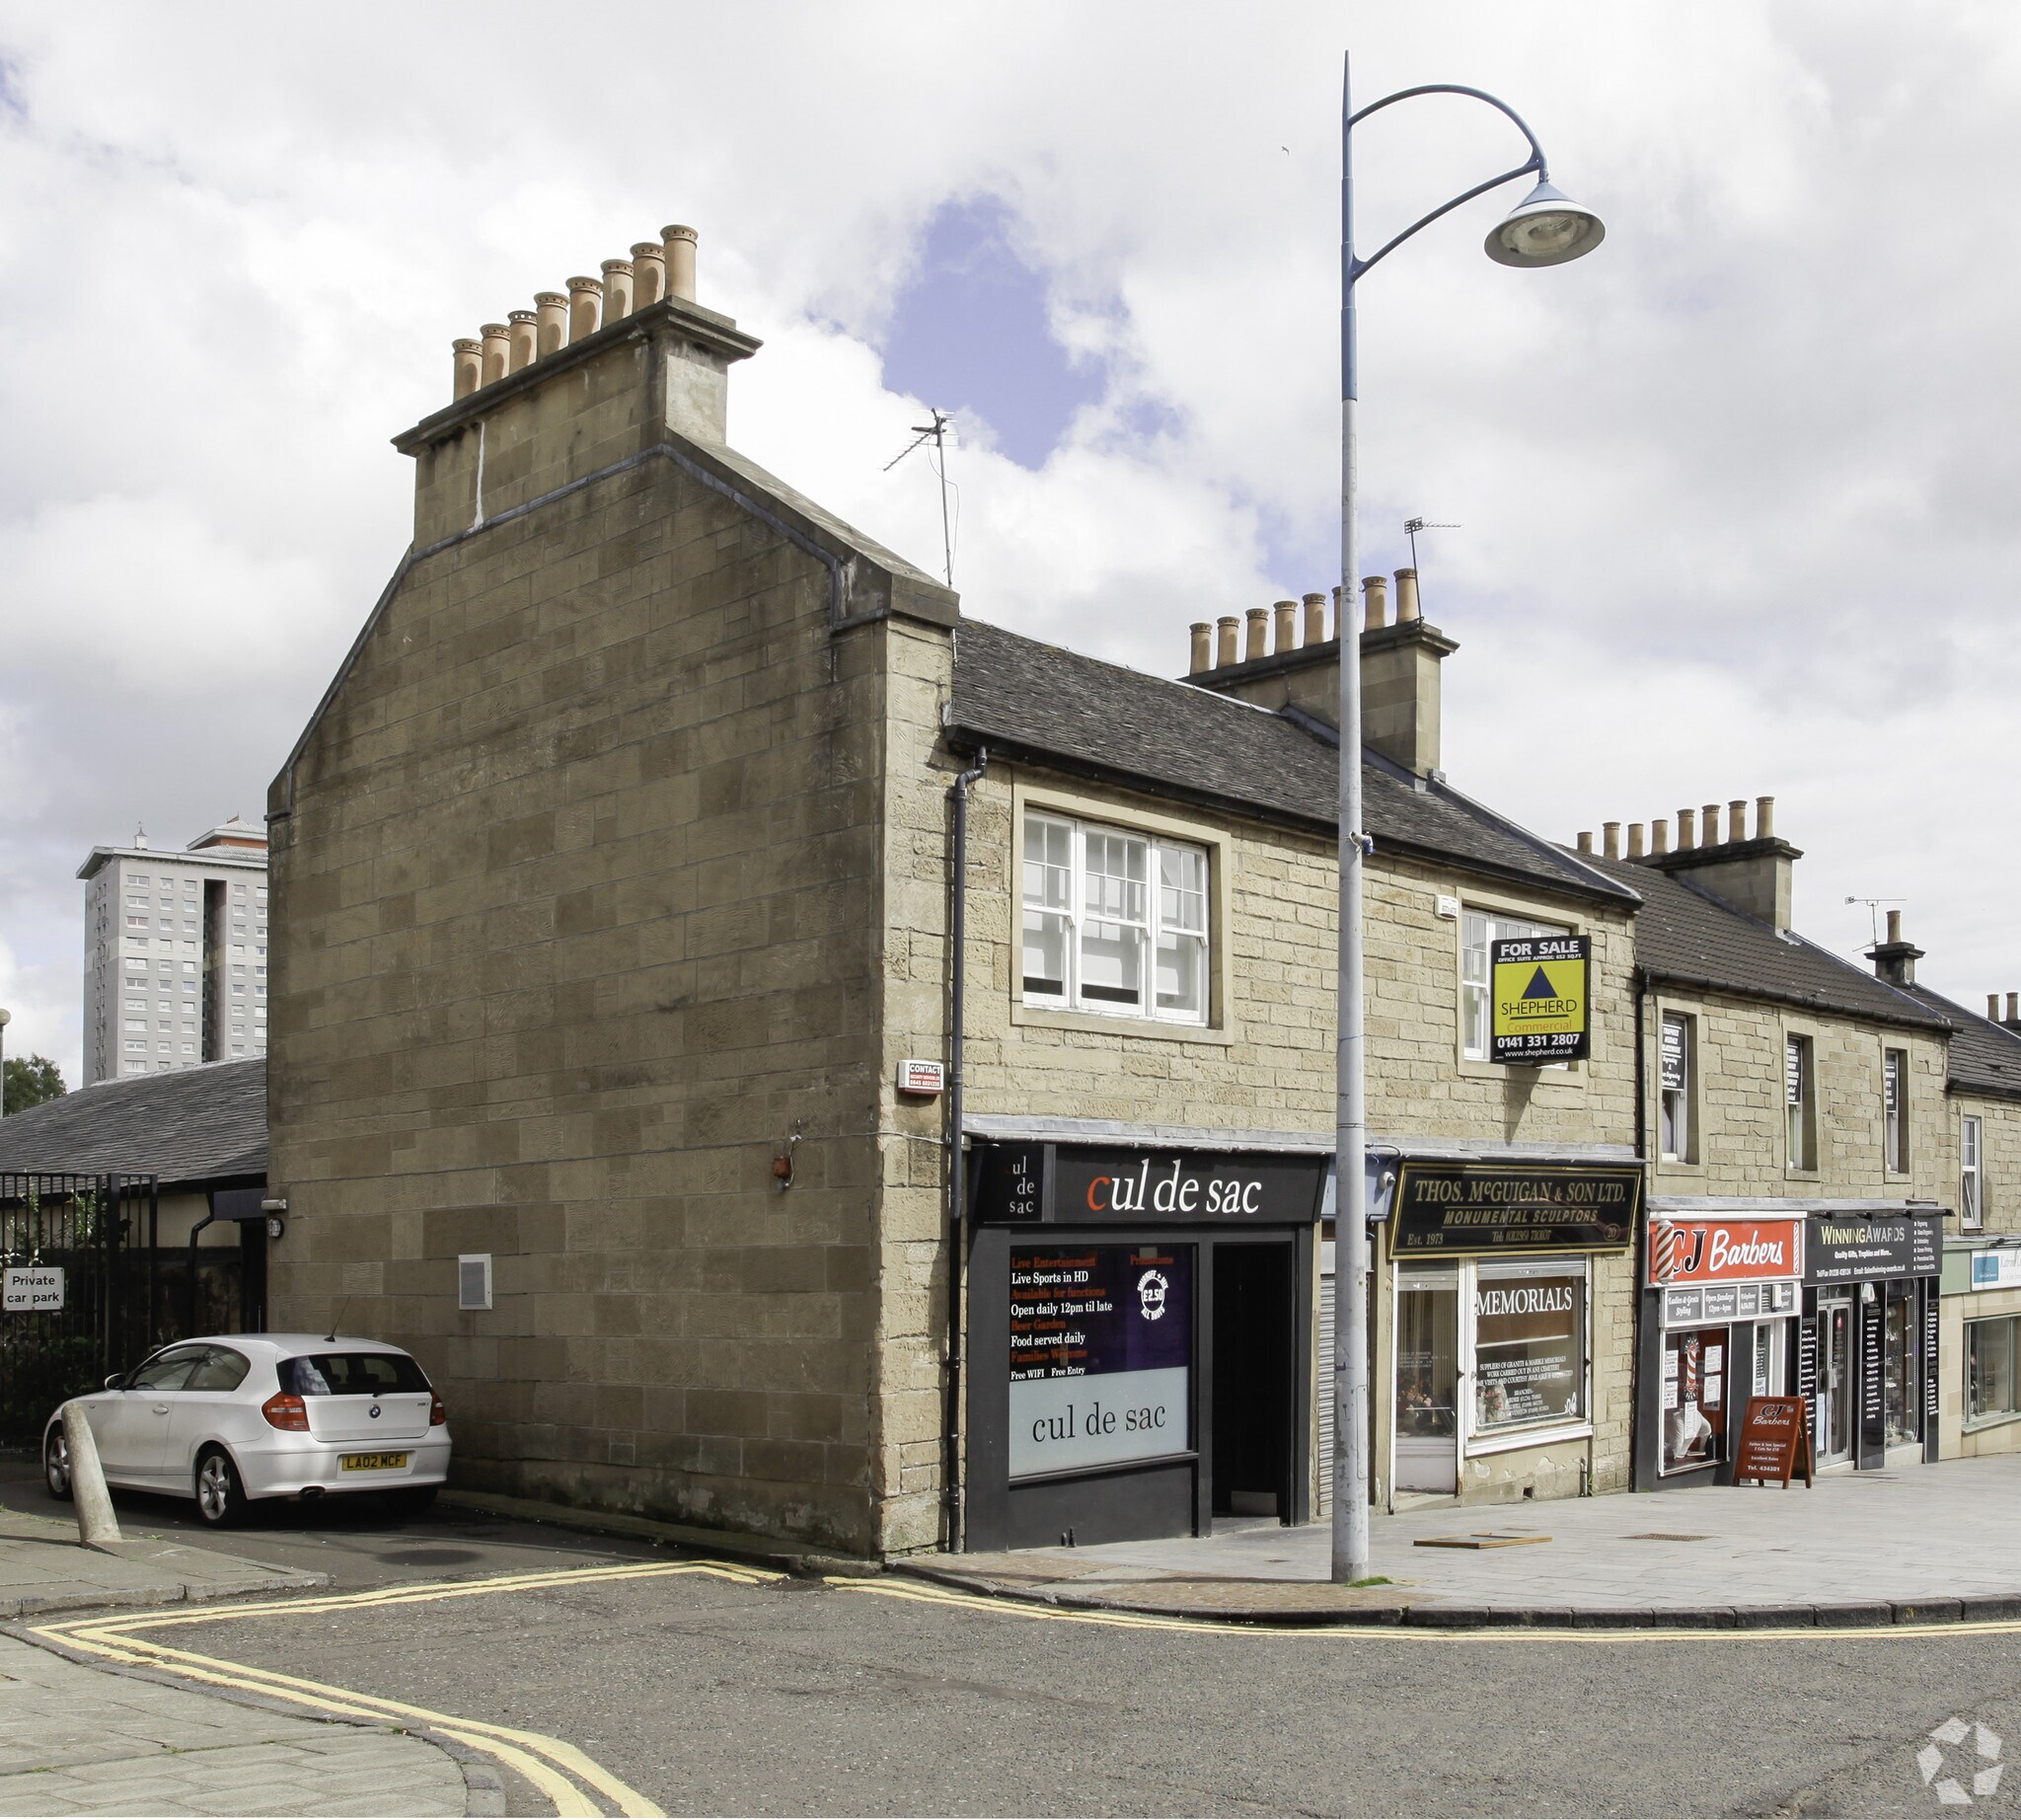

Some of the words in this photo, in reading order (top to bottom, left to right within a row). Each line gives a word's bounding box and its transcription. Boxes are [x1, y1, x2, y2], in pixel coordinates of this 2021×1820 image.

[1500, 943, 1532, 957] FOR
[1539, 941, 1579, 954] SALE
[1501, 999, 1577, 1015] SHEPHERD
[1507, 1020, 1572, 1033] Commercial
[1497, 1037, 1523, 1048] 0141
[1527, 1035, 1547, 1047] 331
[1551, 1033, 1580, 1046] 2807
[1505, 1047, 1573, 1057] www.shepherd.co.uk
[910, 1065, 940, 1074] CONTACT
[1017, 1177, 1035, 1195] de
[1087, 1158, 1149, 1211] cul
[1153, 1159, 1199, 1212] de
[1206, 1179, 1262, 1213] sac
[1415, 1180, 1463, 1202] THOS.
[1554, 1187, 1562, 1201] &
[1566, 1183, 1597, 1202] SON
[1597, 1184, 1626, 1202] LTD.
[1009, 1201, 1034, 1214] sac
[1444, 1210, 1528, 1225] MONUMENTAL
[1532, 1209, 1598, 1223] SCULPTORS
[1407, 1234, 1422, 1246] Est.
[1426, 1234, 1443, 1245] 1973
[1607, 1228, 1617, 1238] 20
[1708, 1229, 1783, 1272] Barbers
[1011, 1257, 1031, 1268] Live
[1034, 1256, 1095, 1268] Entertainment
[12, 1275, 55, 1285] Private
[1011, 1273, 1031, 1284] Live
[1033, 1272, 1061, 1285] Sports
[1063, 1271, 1071, 1283] in
[1074, 1271, 1089, 1282] HD
[32, 1292, 59, 1305] park
[1011, 1288, 1051, 1300] Available
[1053, 1287, 1066, 1298] for
[1068, 1287, 1105, 1297] functions
[1143, 1289, 1163, 1302] £2.50
[1477, 1286, 1572, 1316] MEMORIALS
[1011, 1304, 1034, 1318] Open
[1037, 1303, 1058, 1316] daily
[1061, 1302, 1084, 1315] 12pm
[1085, 1301, 1095, 1312] til
[1097, 1301, 1113, 1311] late
[1011, 1320, 1031, 1331] Beer
[1034, 1319, 1066, 1330] Garden
[1011, 1335, 1032, 1347] Food
[1034, 1333, 1062, 1345] served
[1064, 1331, 1085, 1345] daily
[1544, 1356, 1566, 1364] MEMORIALS
[1011, 1371, 1026, 1380] Free
[1027, 1368, 1044, 1378] WIFI
[1051, 1367, 1066, 1376] Free
[1067, 1366, 1085, 1375] Entry
[1760, 1404, 1785, 1417] CJ
[1033, 1404, 1075, 1442] cul
[1086, 1402, 1116, 1436] de
[1125, 1405, 1166, 1431] sac
[1753, 1416, 1790, 1426] Barbers
[347, 1457, 378, 1468] LA02
[380, 1455, 402, 1466] MCF
